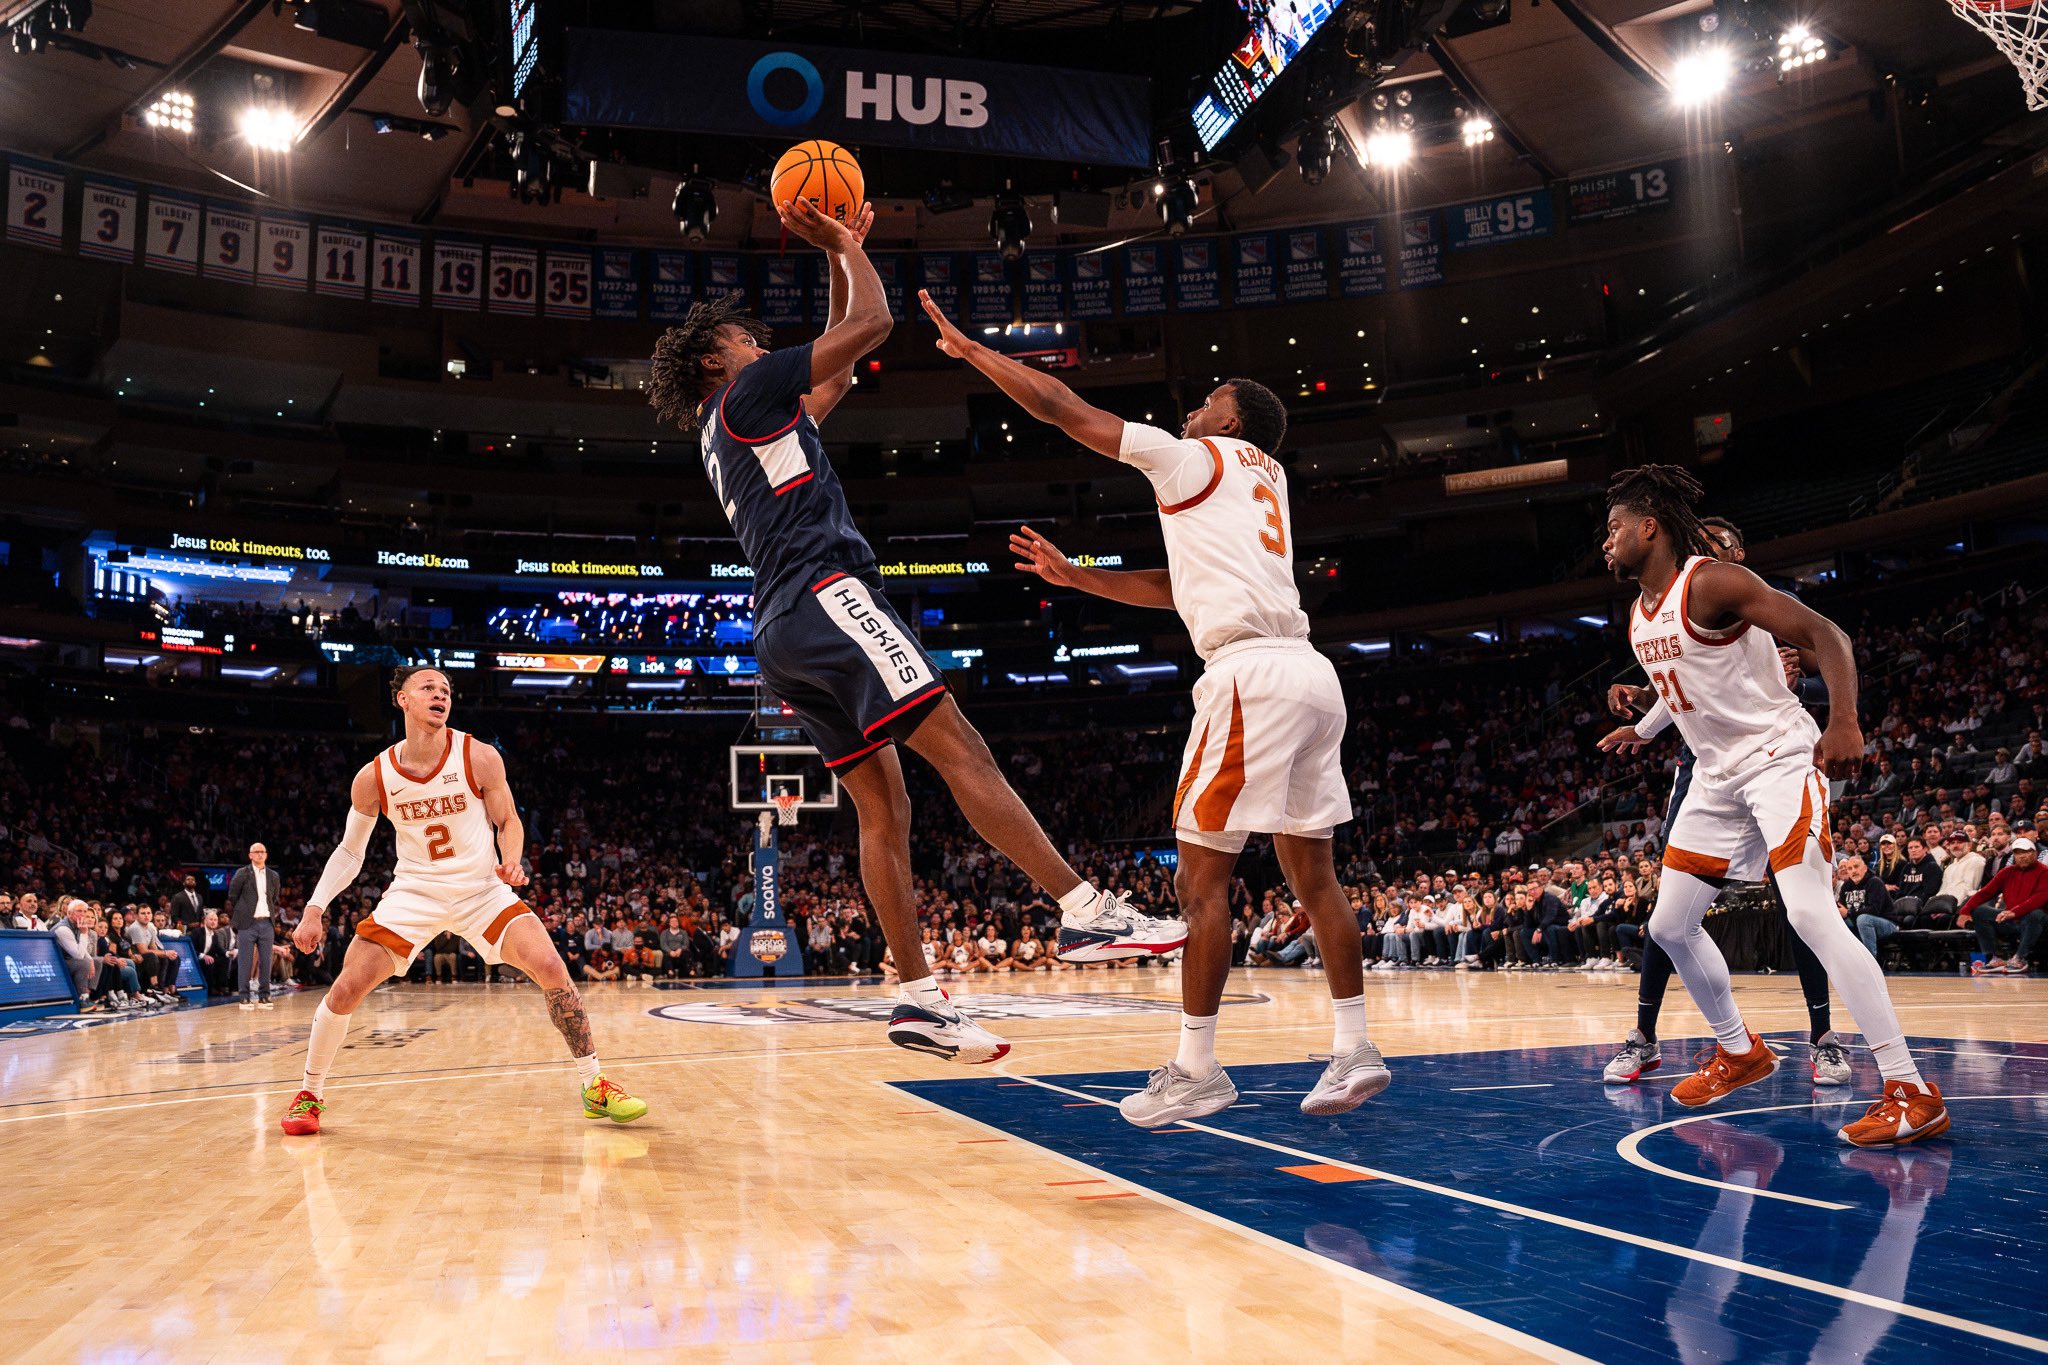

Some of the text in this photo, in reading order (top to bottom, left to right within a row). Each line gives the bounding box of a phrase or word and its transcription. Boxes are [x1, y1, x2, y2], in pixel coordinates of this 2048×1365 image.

[846, 71, 989, 129] HUB
[18, 176, 55, 194] LEETCH
[1569, 176, 1616, 197] PHISH
[1630, 168, 1668, 200] 13
[24, 192, 47, 228] 2
[97, 209, 119, 242] 3
[155, 205, 192, 221] GILBERT
[1464, 205, 1492, 223] BILLY
[1496, 197, 1535, 233] 95
[162, 220, 184, 254] 7
[1468, 221, 1493, 238] JOEL
[220, 232, 240, 264] 9
[273, 240, 294, 273] 9
[326, 248, 355, 282] 11
[381, 256, 410, 290] 11
[440, 261, 475, 294] 19
[494, 266, 532, 299] 30
[549, 271, 588, 303] 35
[1235, 447, 1280, 483] ABMAS
[1253, 482, 1287, 558] 3
[170, 533, 331, 561] Jesus took timeouts, too.
[377, 551, 470, 570] HeGetsUs.com
[515, 559, 664, 577] Jesus took timeouts, too.
[880, 562, 990, 576] took timeouts, too.
[162, 627, 204, 638] WISCONSIN
[834, 588, 919, 684] HUSKIES
[333, 651, 340, 662] 1
[497, 655, 545, 668] TEXAS
[611, 657, 629, 669] 32
[674, 658, 692, 670] 42
[962, 657, 971, 667] 2
[1071, 644, 1140, 657] @THEGARDEN
[1635, 633, 1684, 666] TEXAS
[639, 662, 665, 674] 1:04
[1653, 667, 1696, 715] 21
[395, 793, 467, 821] TEXAS
[424, 823, 456, 862] 2
[762, 865, 776, 919] saatva
